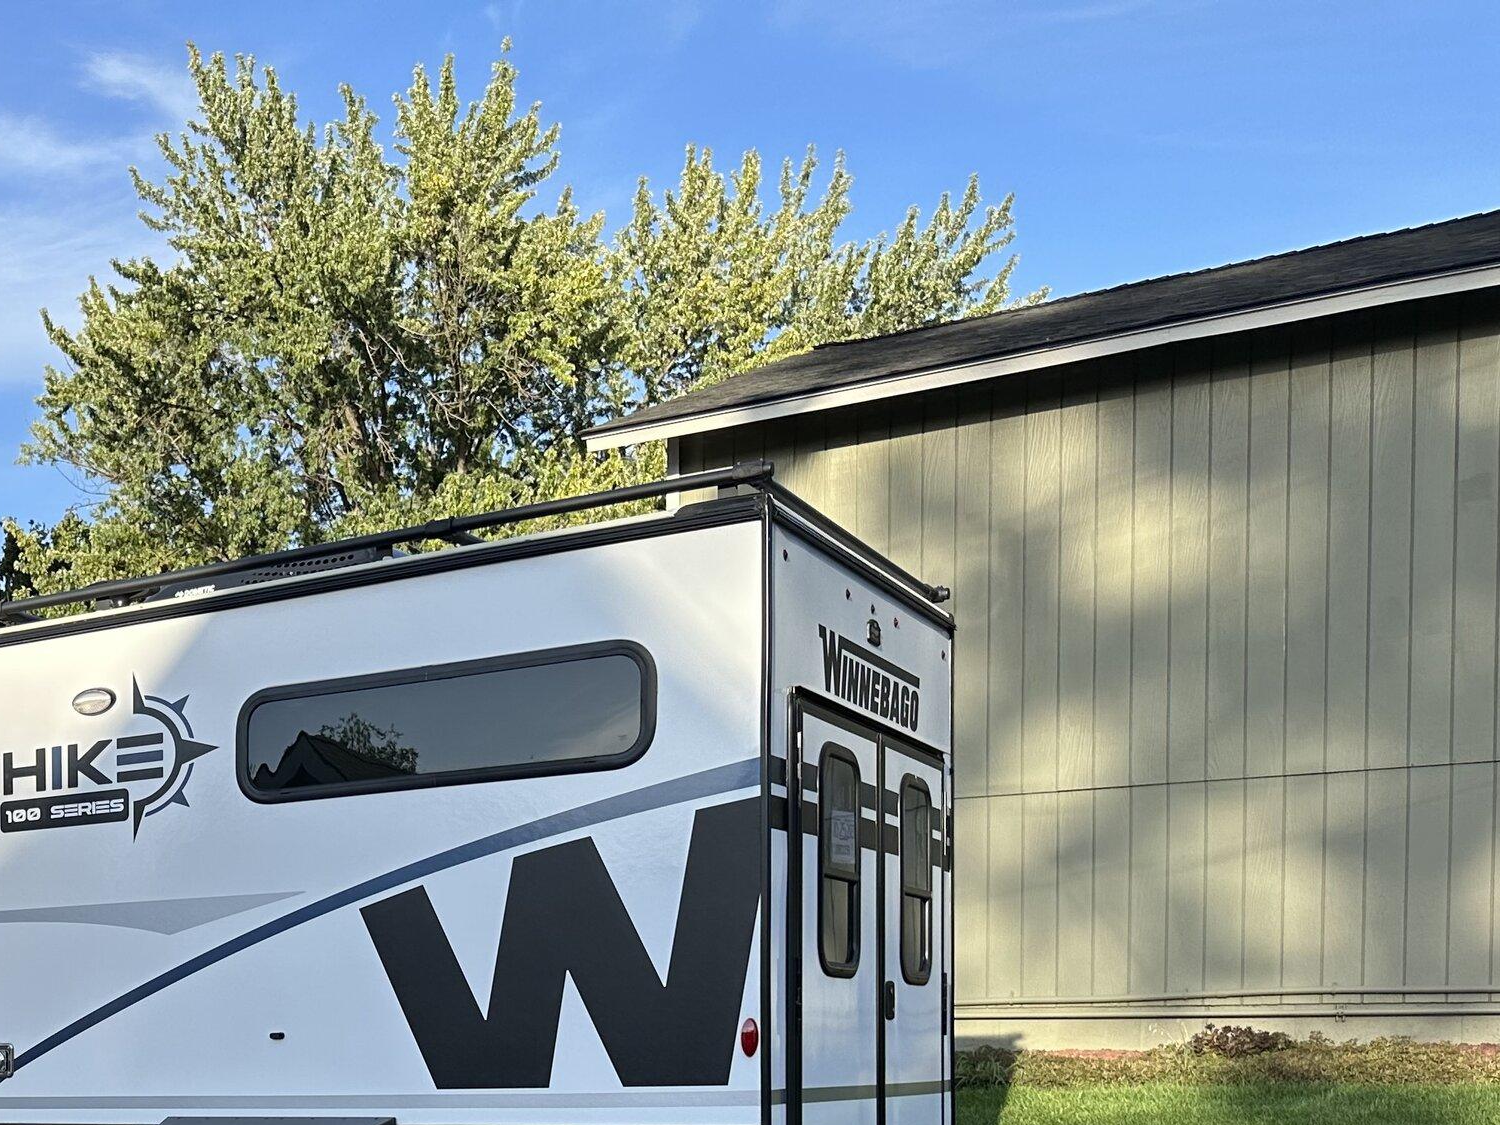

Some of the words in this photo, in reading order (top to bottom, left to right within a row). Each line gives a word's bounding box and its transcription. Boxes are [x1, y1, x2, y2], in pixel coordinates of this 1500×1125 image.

[818, 624, 921, 733] WINNEBAGO
[3, 732, 164, 796] HIKE
[5, 807, 41, 824] 100
[50, 798, 125, 820] SERIES
[359, 796, 762, 1089] W
